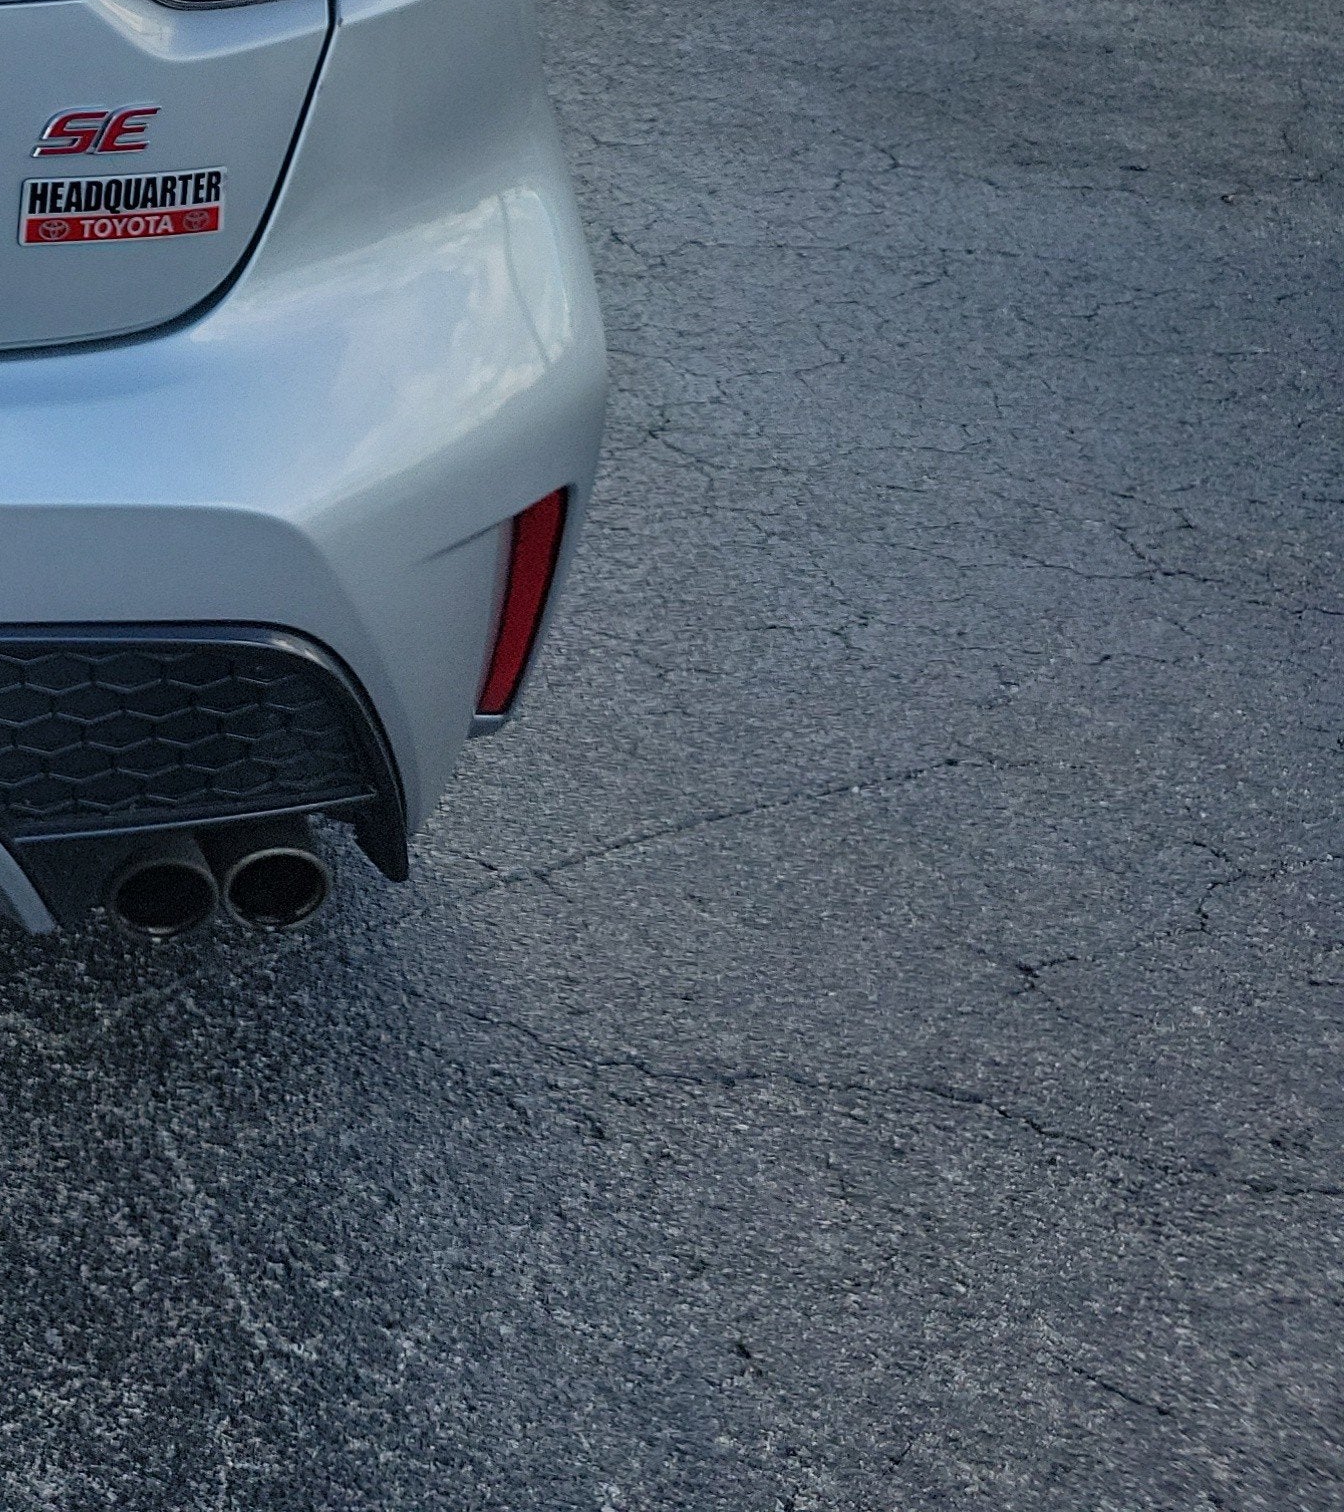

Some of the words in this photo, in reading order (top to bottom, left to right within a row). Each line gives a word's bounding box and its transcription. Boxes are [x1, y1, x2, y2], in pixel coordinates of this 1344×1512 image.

[30, 103, 162, 158] SE
[27, 170, 222, 215] HEADQUARTER
[79, 214, 175, 239] TOYOTA
